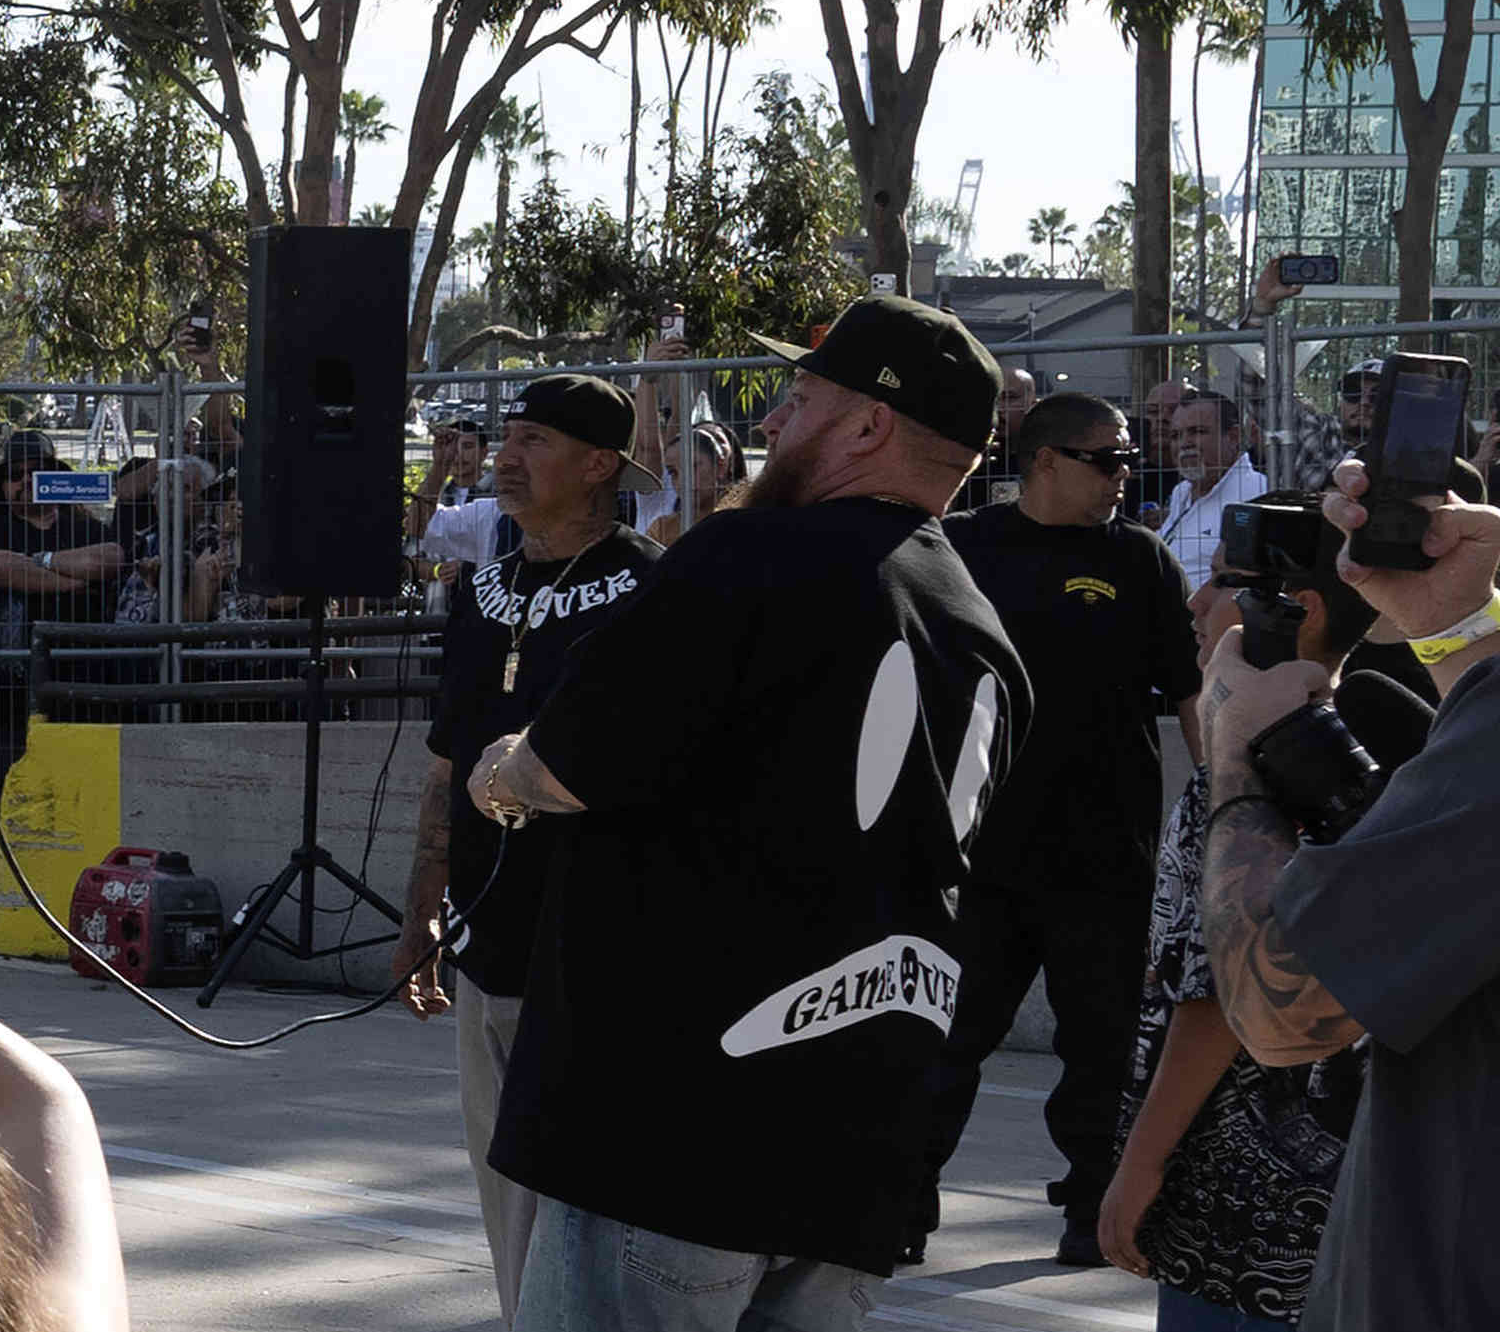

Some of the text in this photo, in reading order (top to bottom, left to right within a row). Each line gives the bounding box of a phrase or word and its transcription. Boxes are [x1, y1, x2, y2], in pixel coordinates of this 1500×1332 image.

[472, 563, 638, 629] GAME OVER
[782, 945, 956, 1035] GAME OVE
